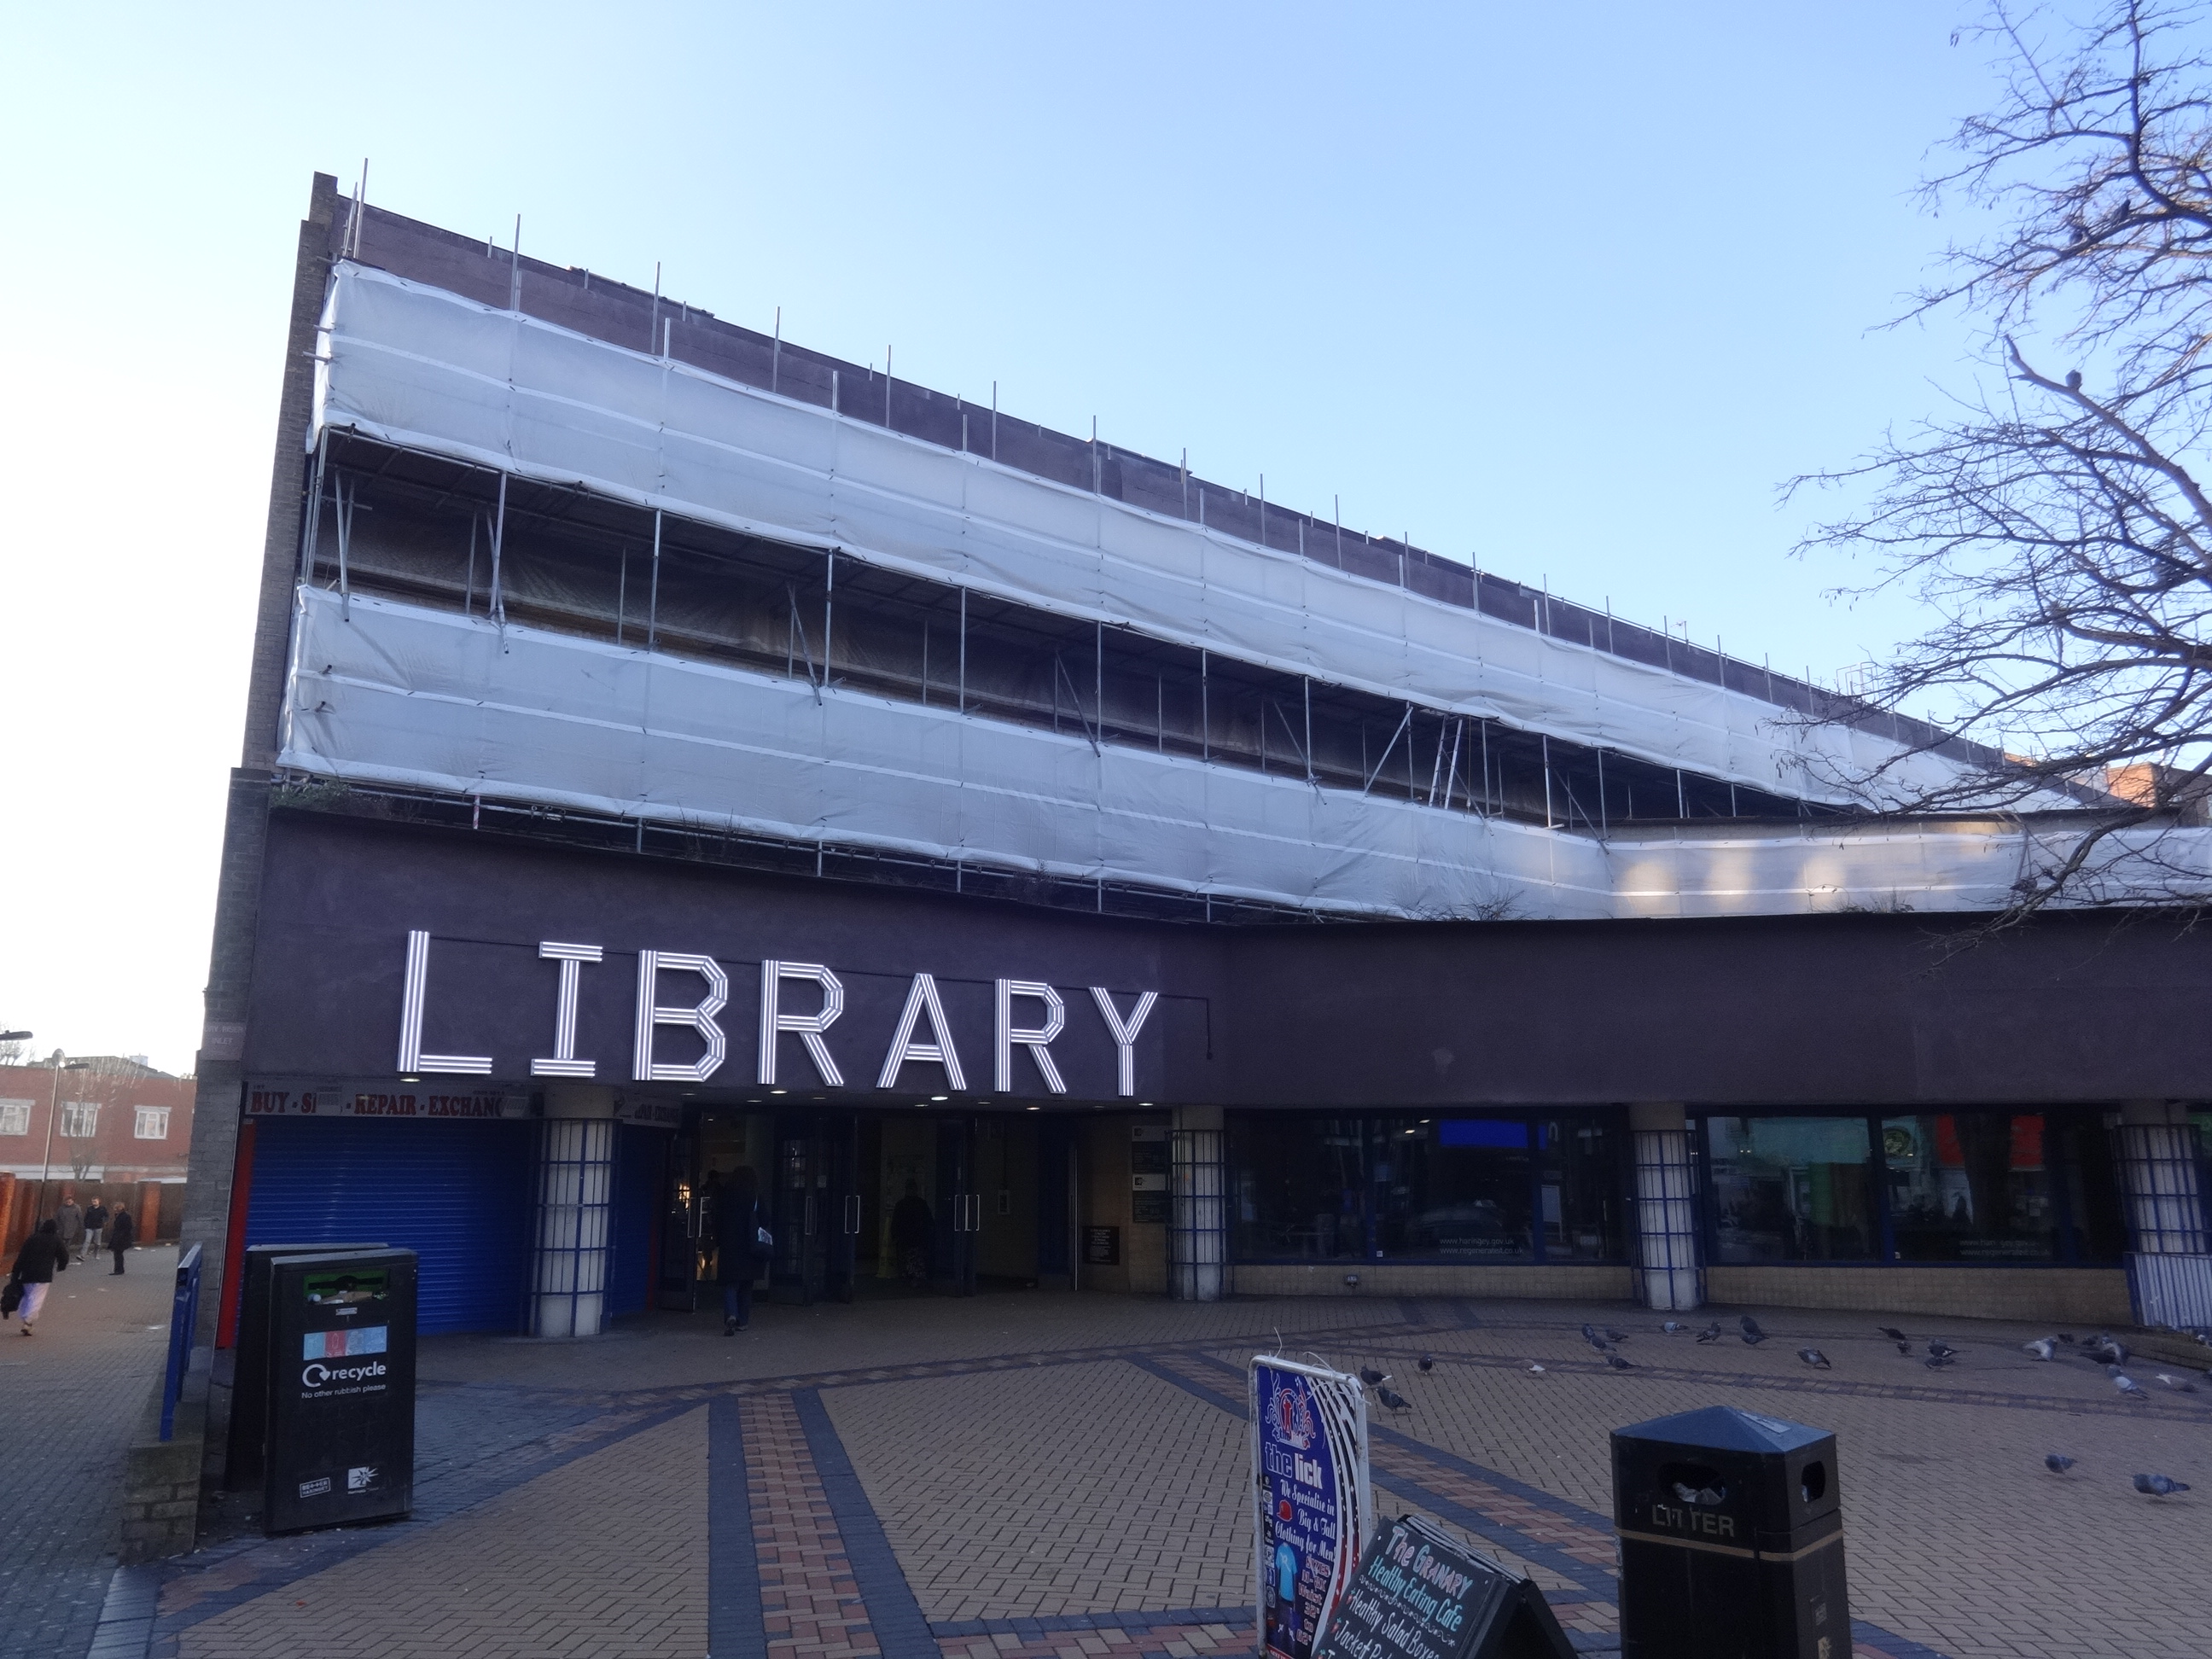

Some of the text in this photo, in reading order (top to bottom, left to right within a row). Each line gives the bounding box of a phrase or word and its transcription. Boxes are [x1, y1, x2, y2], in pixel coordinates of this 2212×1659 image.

[397, 930, 1158, 1097] LIBRARY
[251, 1091, 290, 1113] BUY
[354, 1094, 416, 1115] REPAIR
[1439, 1237, 1515, 1247] www.haringey.gov.uk
[332, 1361, 387, 1381] recycle
[314, 1389, 333, 1398] other
[335, 1387, 361, 1395] rubbish
[363, 1384, 387, 1393] please
[1265, 1441, 1323, 1489] the lick
[1280, 1479, 1335, 1516] We Specialise in
[1298, 1508, 1336, 1540] Big & Tall
[1652, 1504, 1735, 1537] LITTER
[1275, 1521, 1305, 1552] Clothing
[1306, 1534, 1317, 1554] for
[1385, 1525, 1474, 1600] The GRANARY
[1299, 1582, 1323, 1605] Waist
[1368, 1555, 1406, 1600] Healthy
[1403, 1577, 1438, 1621] Eating
[1349, 1589, 1383, 1633] Healthy
[1381, 1612, 1414, 1649] Salad
[1334, 1620, 1373, 1659] Jacket
